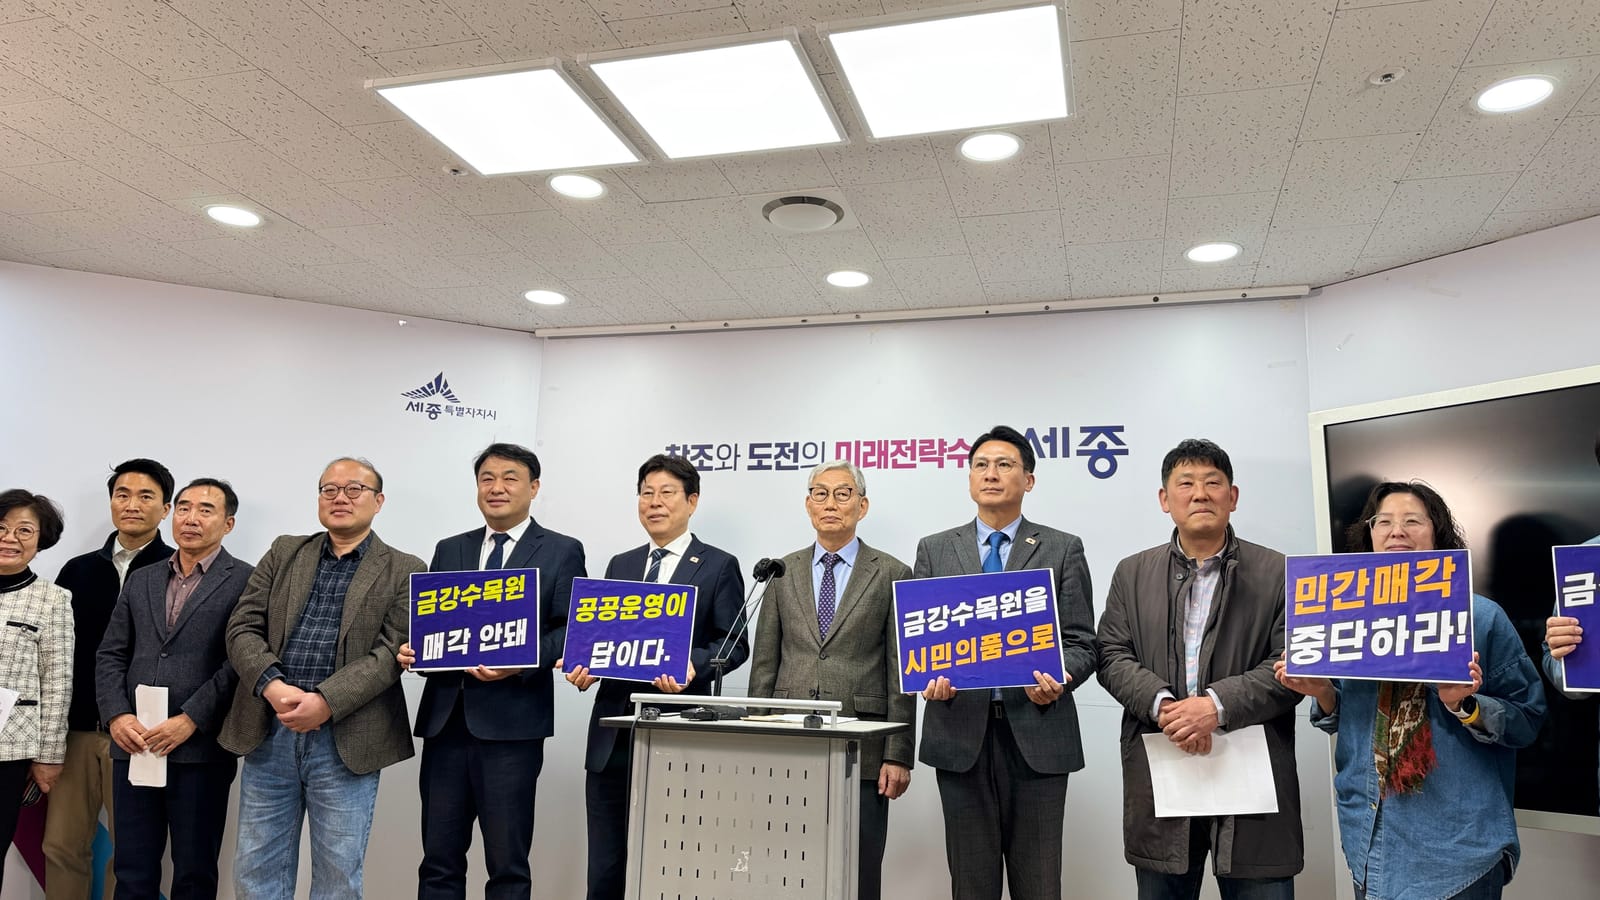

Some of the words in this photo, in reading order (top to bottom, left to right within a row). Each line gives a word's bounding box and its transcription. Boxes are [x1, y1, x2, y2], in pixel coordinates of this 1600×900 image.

[405, 401, 441, 420] 세종
[747, 441, 825, 471] 도전의
[1024, 425, 1129, 479] 세종
[417, 574, 525, 616] 금강수목원
[575, 592, 688, 622] 공공운영이
[1294, 556, 1456, 616] 민간매각
[1562, 572, 1600, 608] 금
[903, 586, 1048, 638] 금강수목원을
[422, 627, 471, 661] 매각
[479, 618, 528, 652] 안돼
[589, 639, 671, 669] 답이다.
[904, 623, 1055, 675] 시민의품으로
[1290, 610, 1468, 665] 중단하라!
